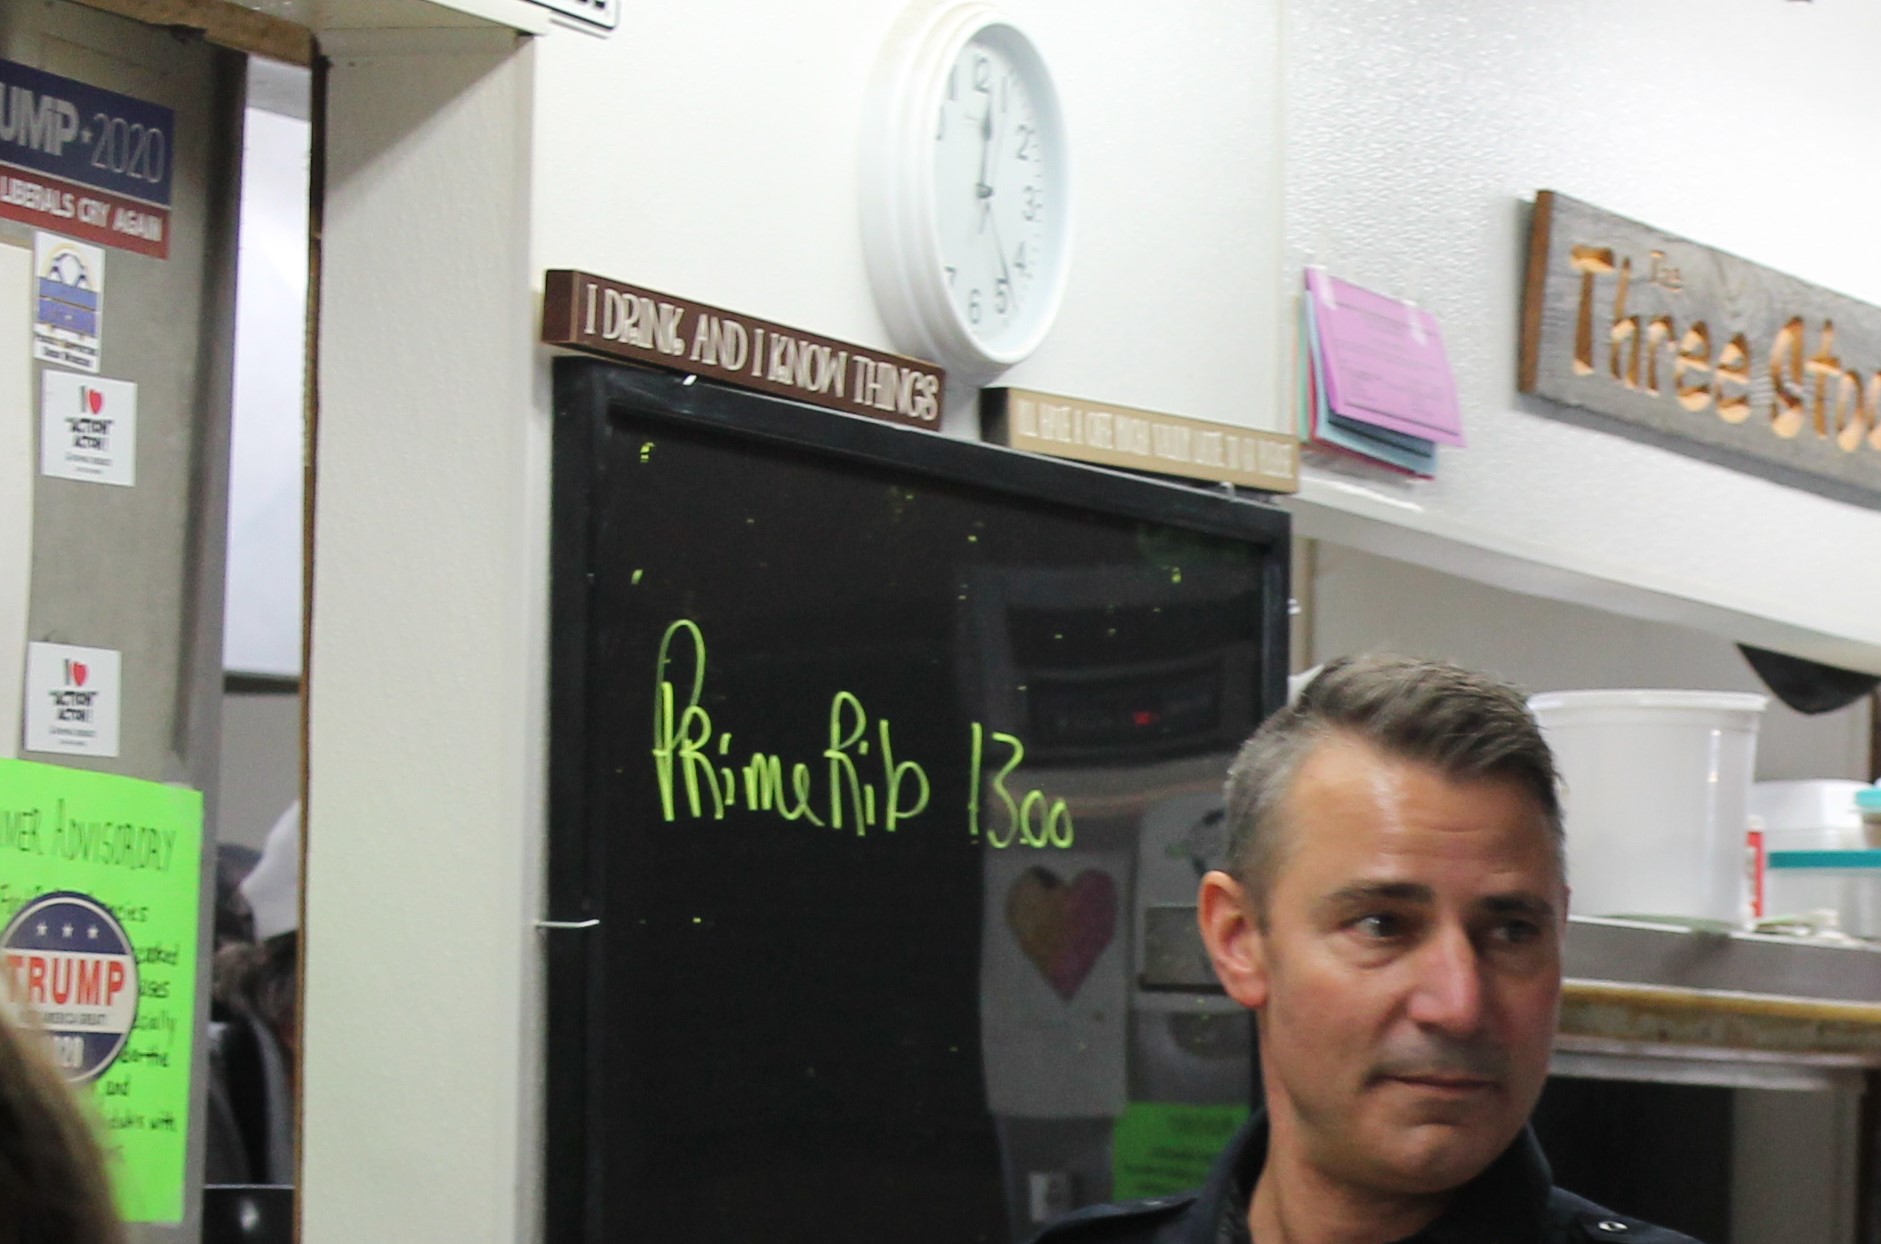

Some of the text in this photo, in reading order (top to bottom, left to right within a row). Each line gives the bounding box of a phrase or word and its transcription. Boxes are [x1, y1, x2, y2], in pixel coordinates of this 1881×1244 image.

[90, 112, 165, 184] 2020
[77, 197, 111, 228] CRY
[112, 207, 163, 242] AGAIN
[584, 283, 598, 336] I
[690, 313, 748, 371] AND
[751, 328, 764, 377] I
[767, 332, 848, 398] KNOW
[852, 355, 940, 421] THINGS
[1569, 245, 1752, 424] Three
[823, 691, 930, 836] Rib
[5, 955, 125, 1007] TRUMP
